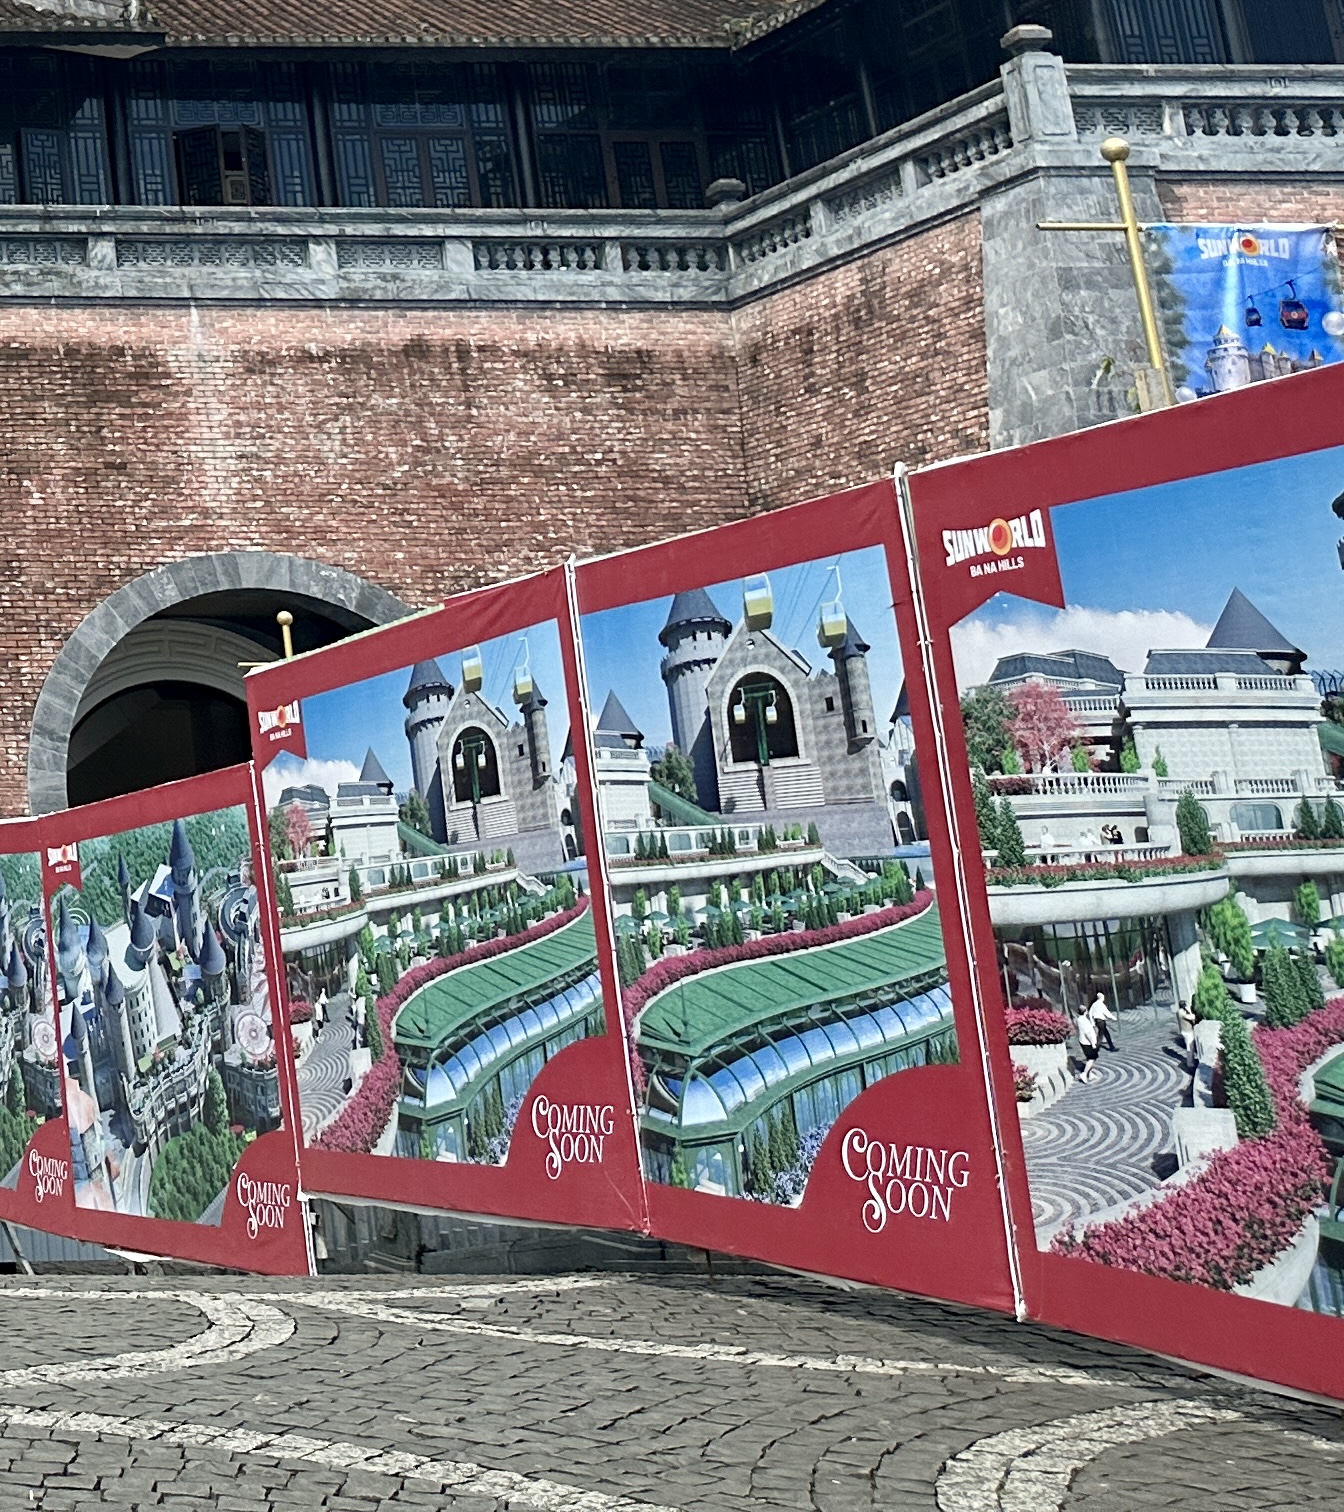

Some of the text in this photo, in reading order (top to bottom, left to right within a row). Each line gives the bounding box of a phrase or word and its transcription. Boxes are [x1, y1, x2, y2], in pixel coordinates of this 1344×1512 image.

[969, 556, 1025, 578] BA NA HILLS
[532, 1095, 614, 1139] COMING
[29, 1149, 68, 1180] COMING
[546, 1128, 605, 1180] SOON
[841, 1128, 970, 1188] COMING
[35, 1173, 63, 1203] SOON
[237, 1172, 290, 1208] COMING
[862, 1171, 954, 1233] SOON
[247, 1200, 285, 1239] SOON
